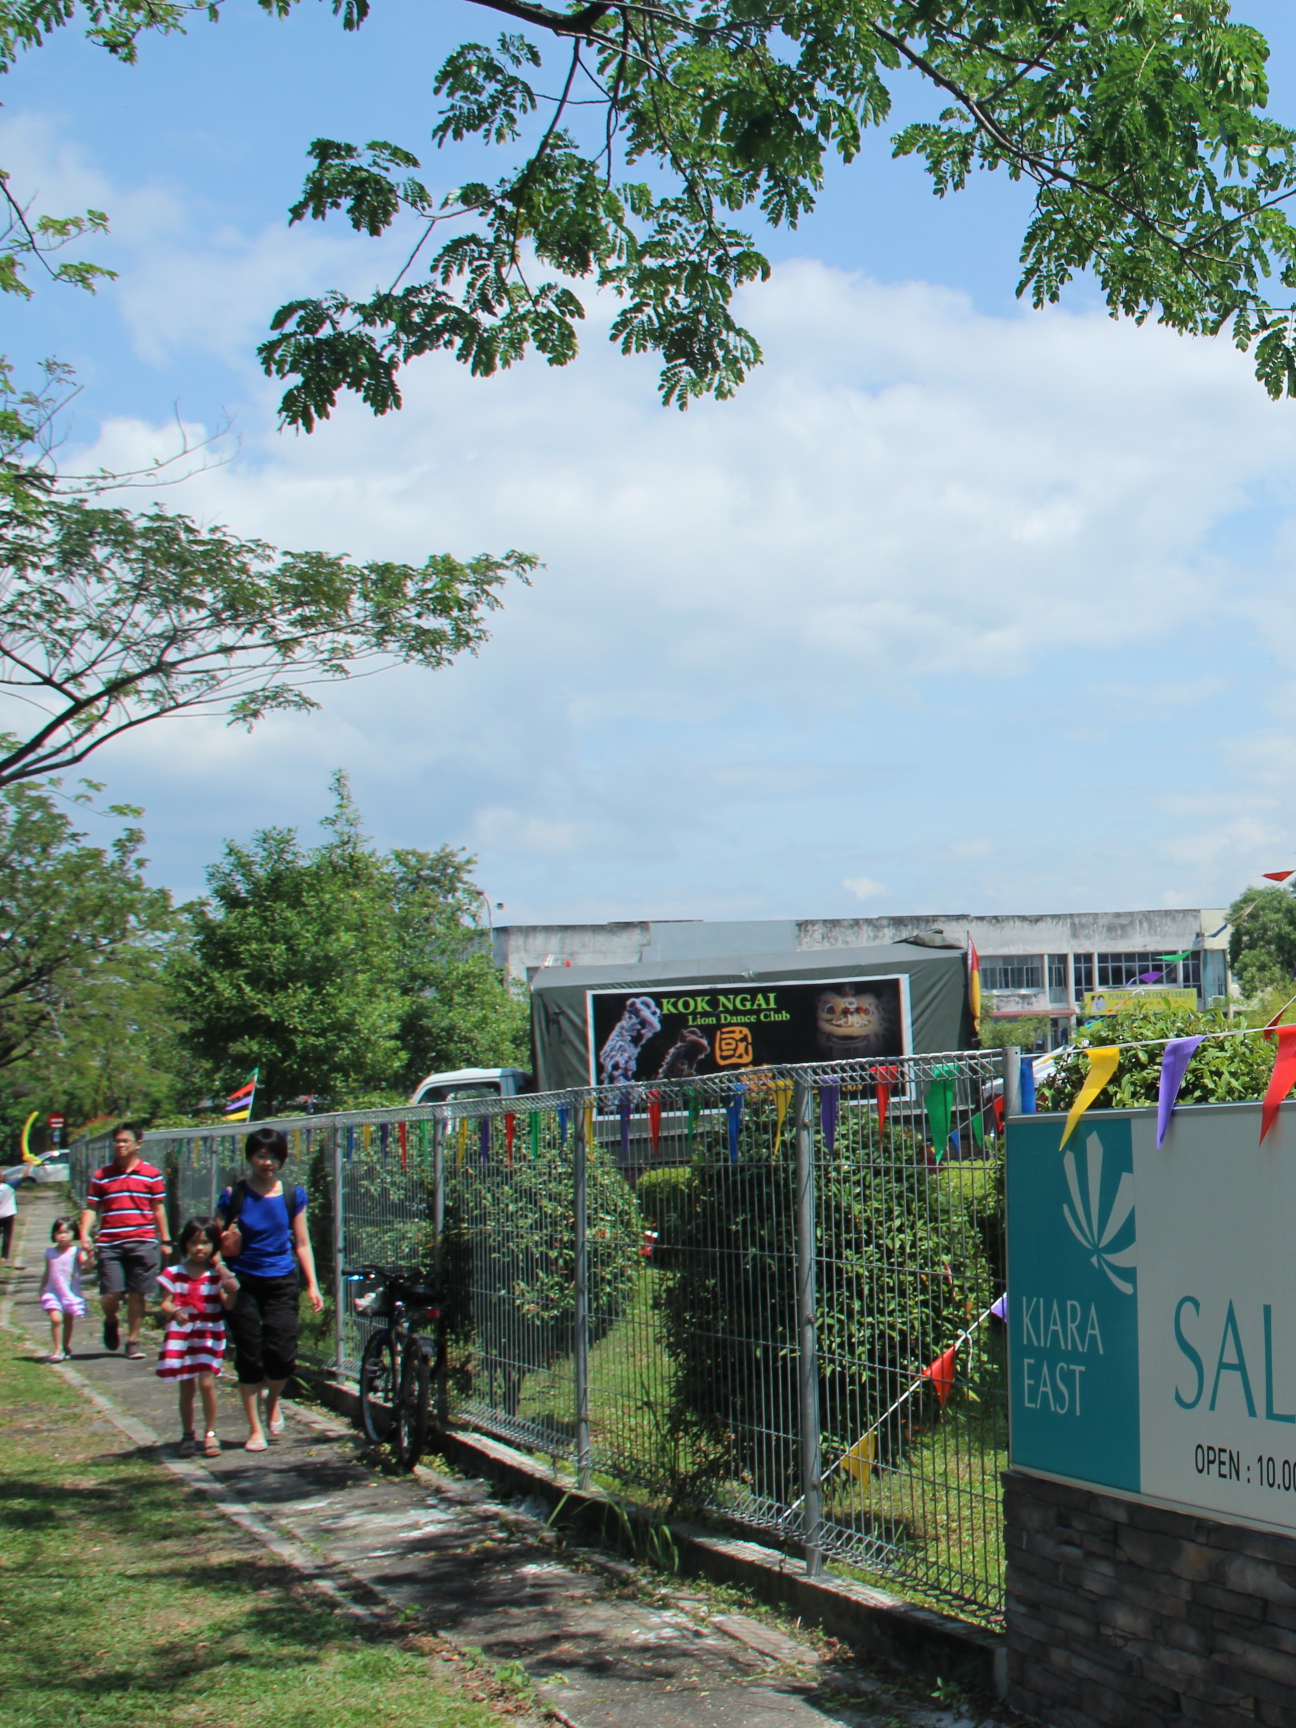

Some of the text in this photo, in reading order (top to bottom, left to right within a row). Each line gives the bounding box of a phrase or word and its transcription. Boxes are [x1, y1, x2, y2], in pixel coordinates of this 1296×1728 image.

[660, 992, 777, 1014] KOK NGAI
[1171, 990, 1194, 998] CERDAS
[687, 1010, 791, 1025] Lion Dance Club
[1022, 1296, 1104, 1355] KIARA
[1023, 1358, 1086, 1417] EAST
[1194, 1443, 1240, 1482] OPEN
